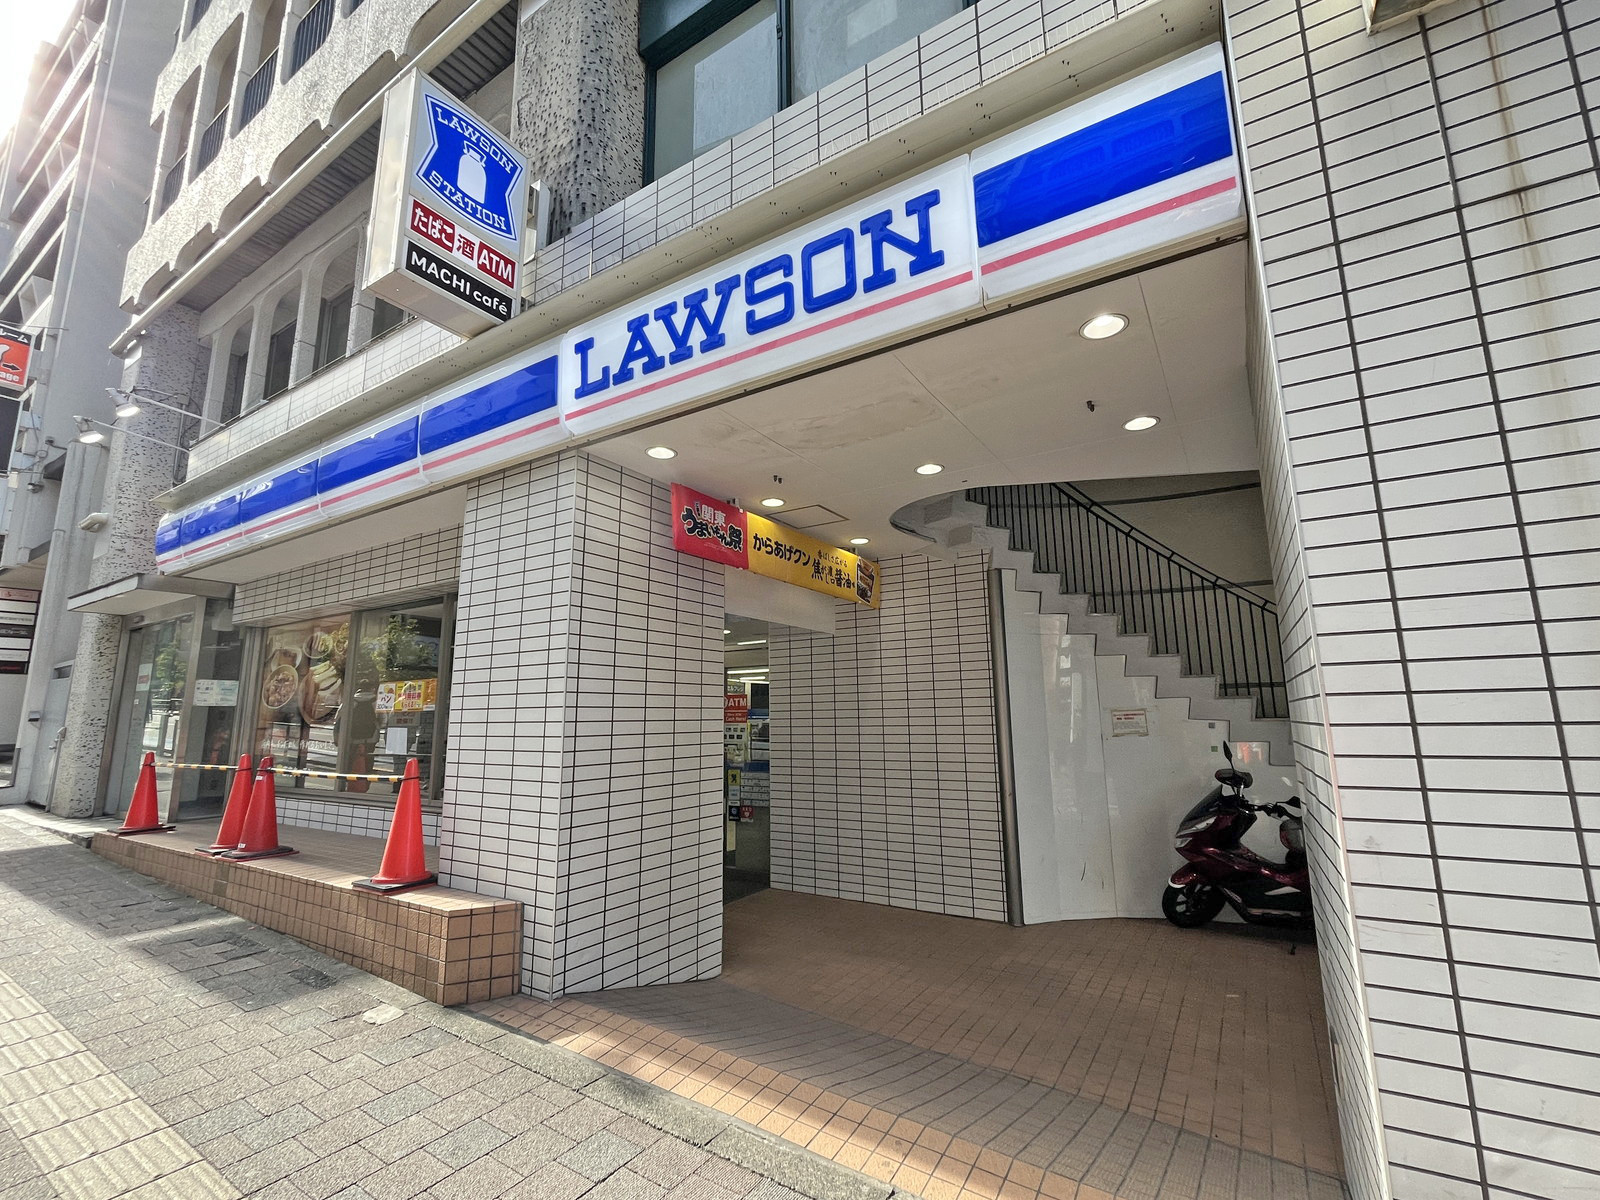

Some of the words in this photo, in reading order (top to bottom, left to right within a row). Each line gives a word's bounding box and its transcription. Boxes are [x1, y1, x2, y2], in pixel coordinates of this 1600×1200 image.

[434, 106, 515, 174] LAWSON
[428, 170, 507, 230] STATION
[413, 206, 454, 248] たばこ
[456, 233, 476, 261] 酒
[478, 247, 513, 283] ATM
[410, 250, 471, 295] MACHI
[473, 290, 508, 316] café
[574, 189, 945, 400] LAWSON
[701, 504, 726, 527] 関東
[753, 533, 812, 567] からあげクン
[728, 698, 747, 707] ATM
